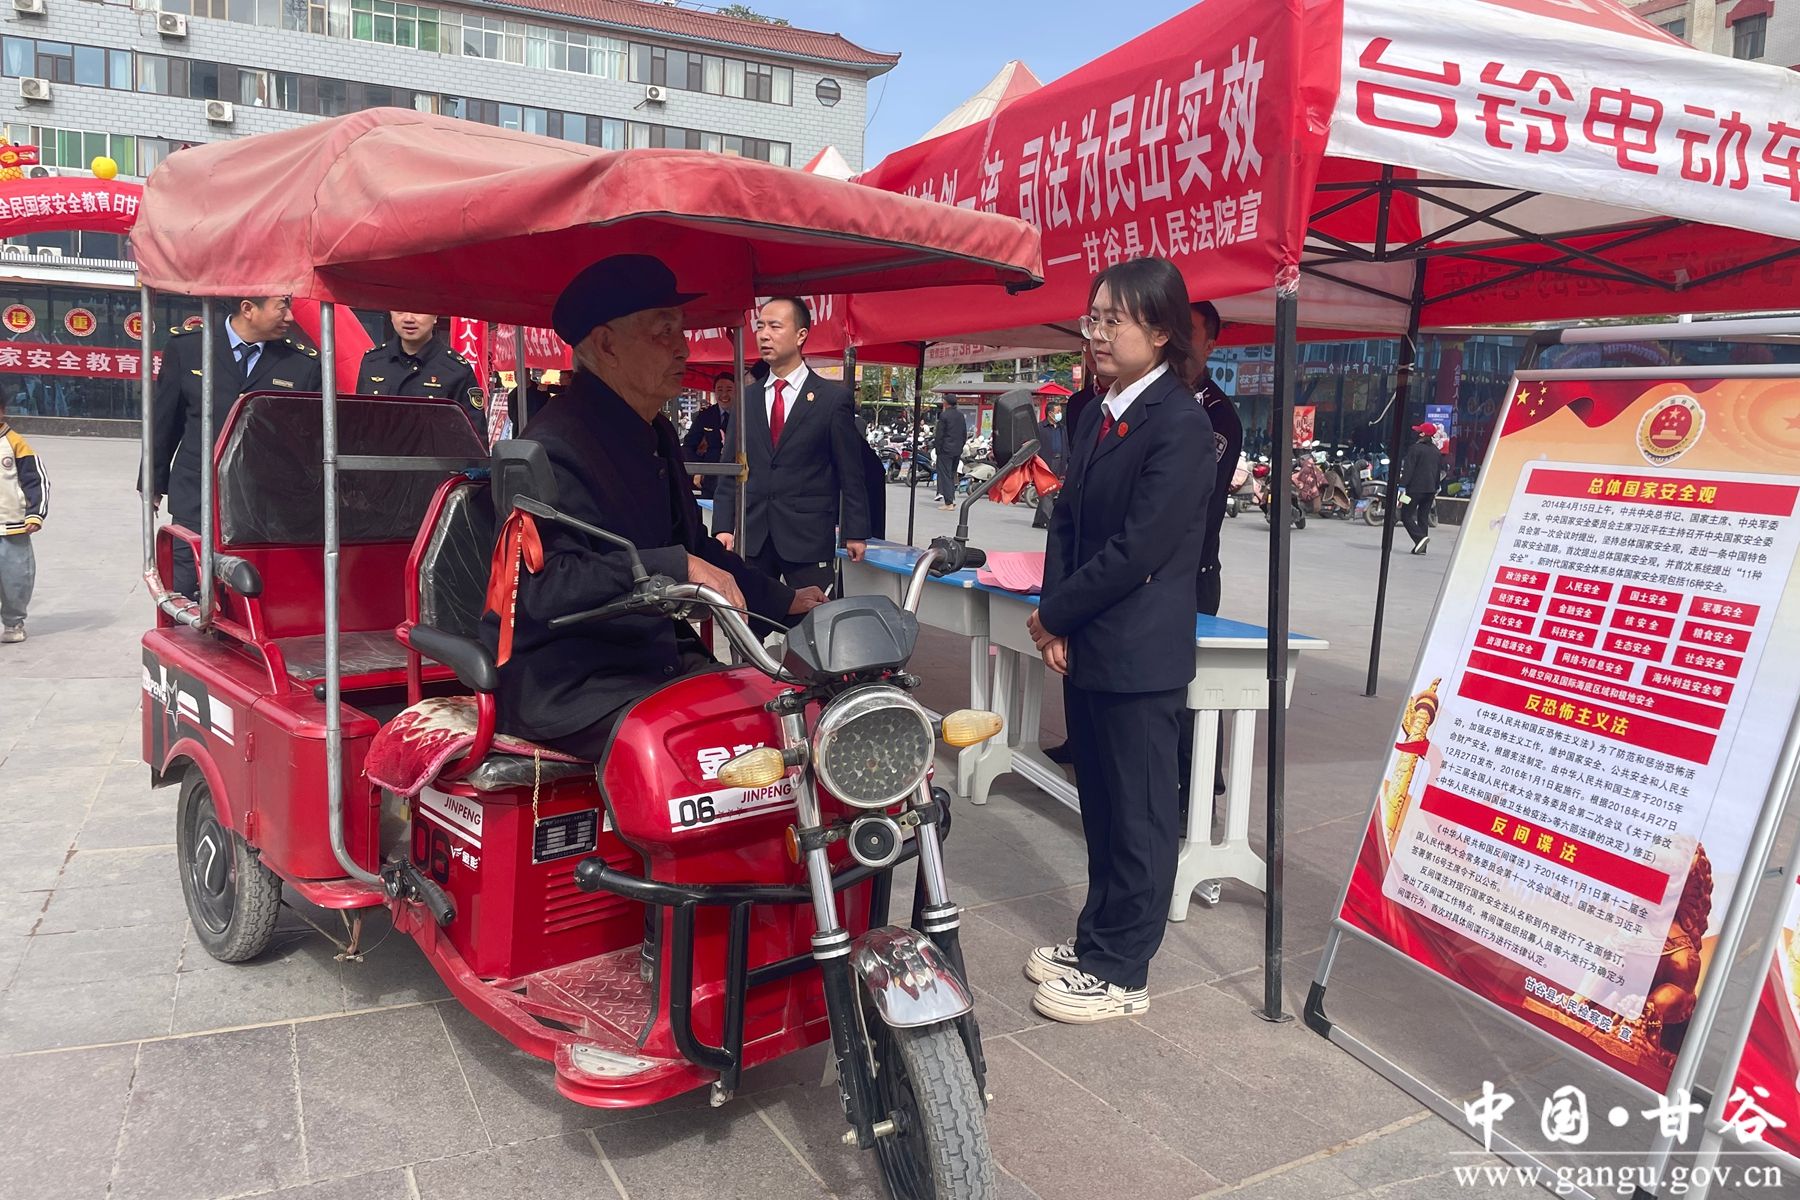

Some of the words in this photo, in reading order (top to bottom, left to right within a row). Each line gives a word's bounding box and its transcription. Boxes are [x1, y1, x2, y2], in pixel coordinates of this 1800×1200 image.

[1018, 36, 1264, 236] 司法为民出实效
[1586, 477, 1719, 504] 总体国家安全观
[1504, 570, 1538, 585] 政治安全
[1564, 580, 1601, 596] 人民安全
[1497, 592, 1530, 607] 经济安全
[1628, 590, 1668, 607] 国土安全
[1557, 603, 1593, 619] 金融安全
[1699, 601, 1744, 619] 军事安全
[1490, 613, 1524, 629] 文化安全
[1549, 625, 1586, 642] 科技安全
[1691, 627, 1735, 645] 粮食安全
[1613, 638, 1652, 655] 生态安全
[1560, 652, 1624, 675] 网络与信息安全
[1683, 652, 1727, 671] 社会安全
[1651, 671, 1723, 698] 海外利益安全等
[1523, 693, 1630, 737] 反恐怖主义法
[741, 783, 792, 804] JINPENG
[444, 797, 481, 826] JINPENG
[679, 796, 716, 827] 06
[1490, 815, 1579, 864] 反间谍法
[413, 816, 450, 885] 06
[1524, 976, 1613, 1032] 甘谷县人民检察院
